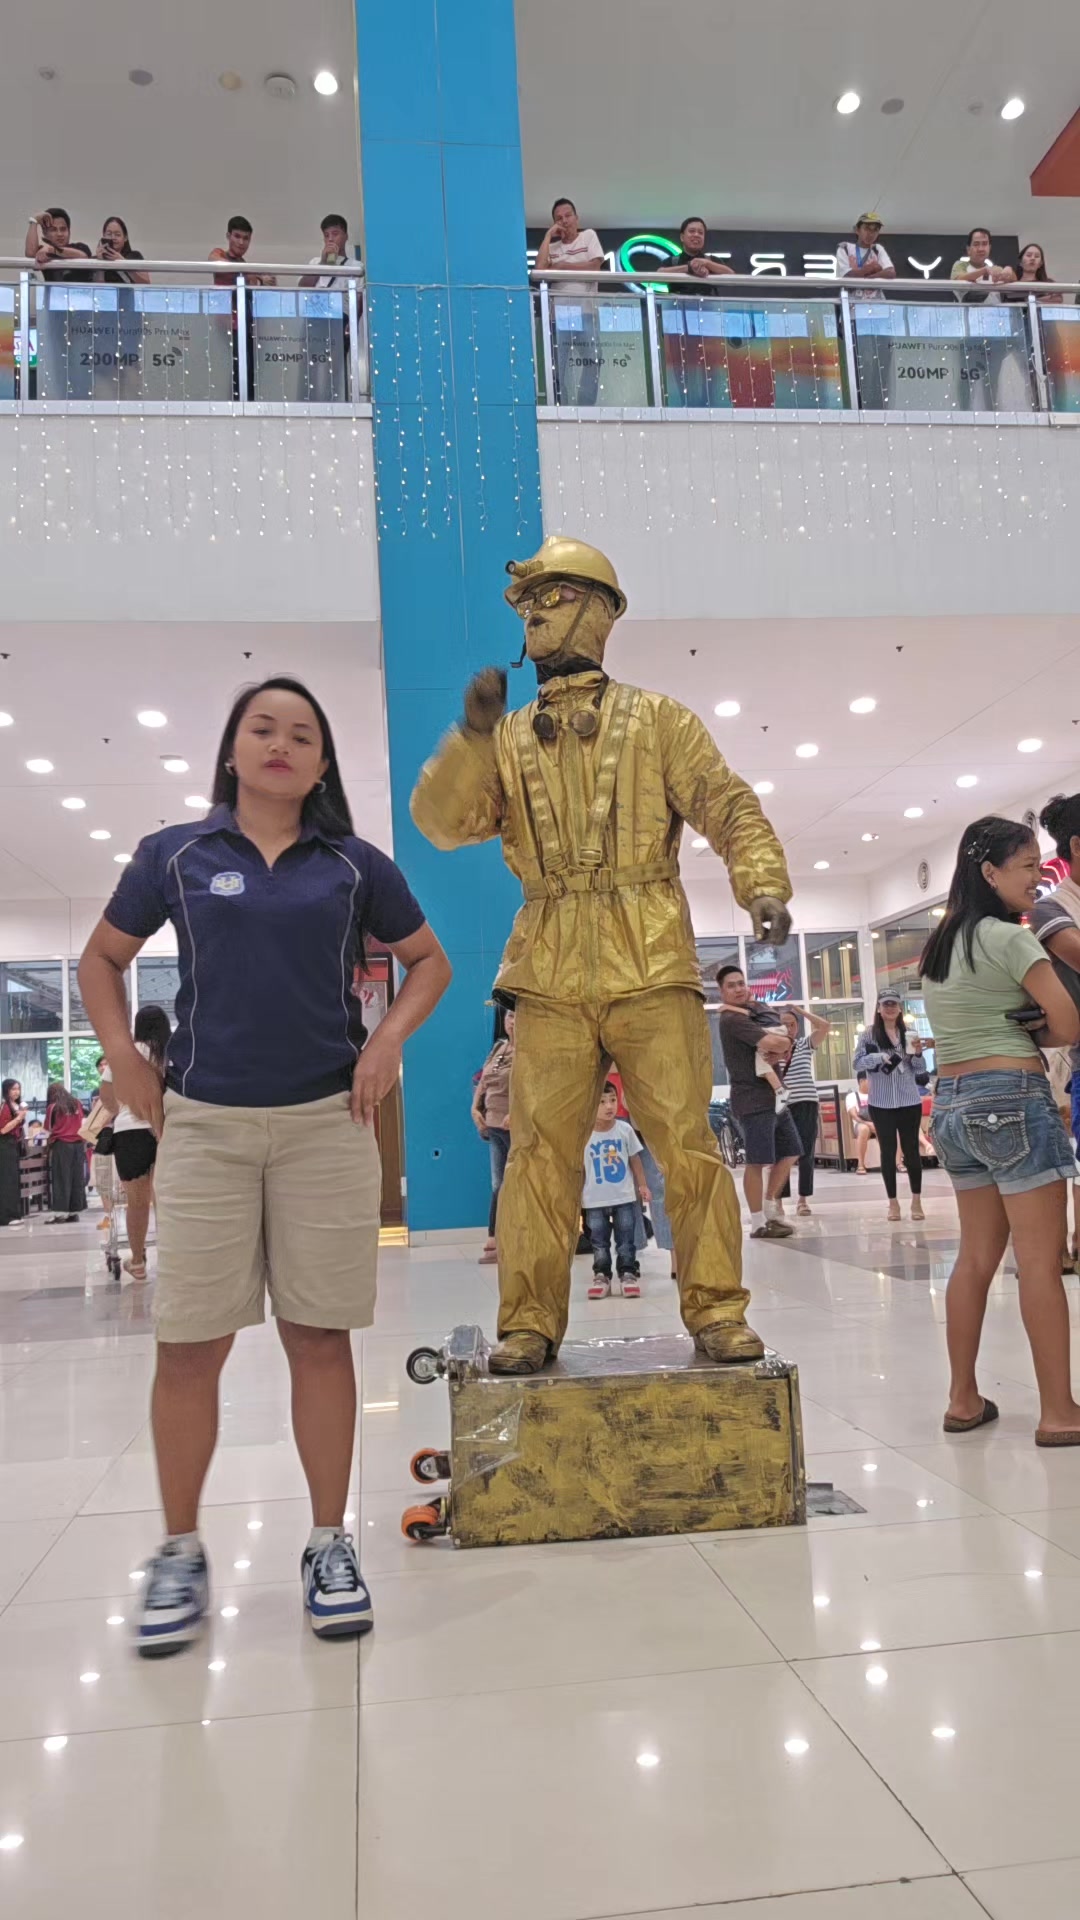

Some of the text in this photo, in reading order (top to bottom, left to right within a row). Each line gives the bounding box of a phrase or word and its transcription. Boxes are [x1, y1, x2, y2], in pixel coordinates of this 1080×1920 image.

[71, 326, 115, 335] HUAWEI
[80, 352, 176, 367] 200MP 5G
[264, 352, 327, 363] 200MP 5G
[897, 366, 981, 380] 200MP 5G
